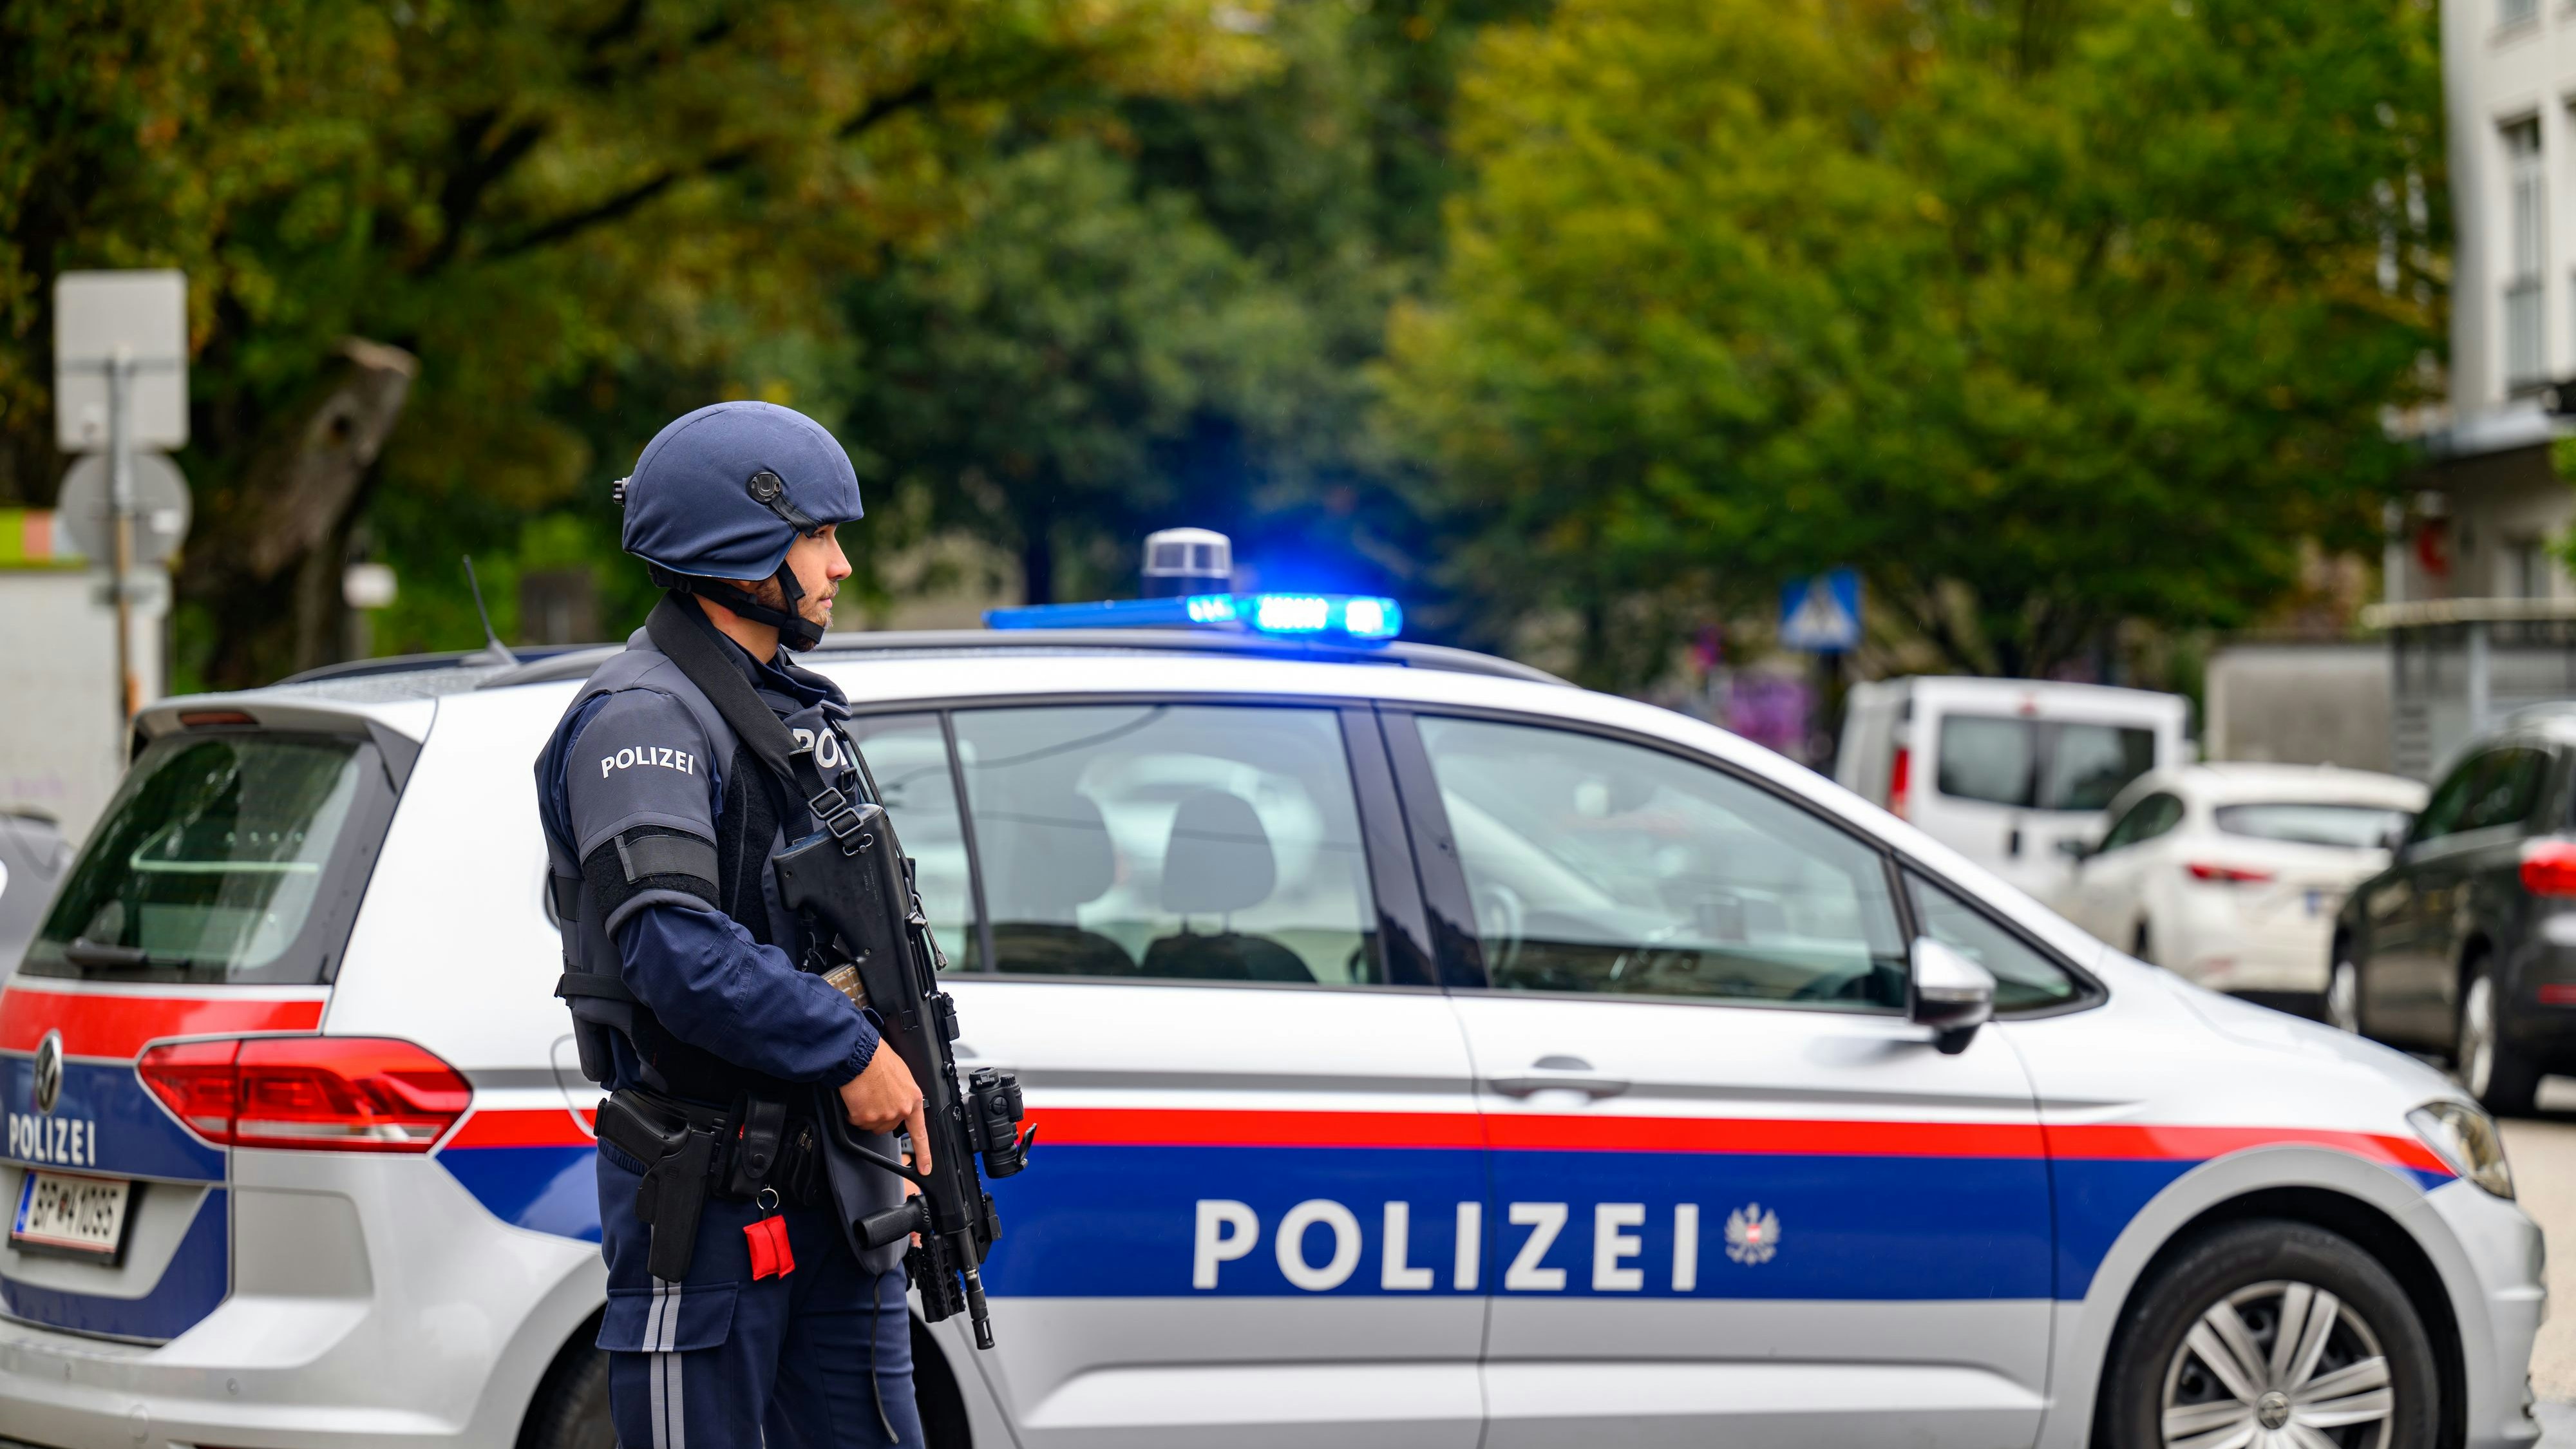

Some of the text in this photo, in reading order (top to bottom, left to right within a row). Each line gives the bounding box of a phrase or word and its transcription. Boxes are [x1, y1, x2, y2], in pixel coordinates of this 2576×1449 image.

[601, 746, 695, 779] POLIZEI
[9, 1113, 95, 1166] POLIZEI
[1192, 1198, 1699, 1292] POLIZEI
